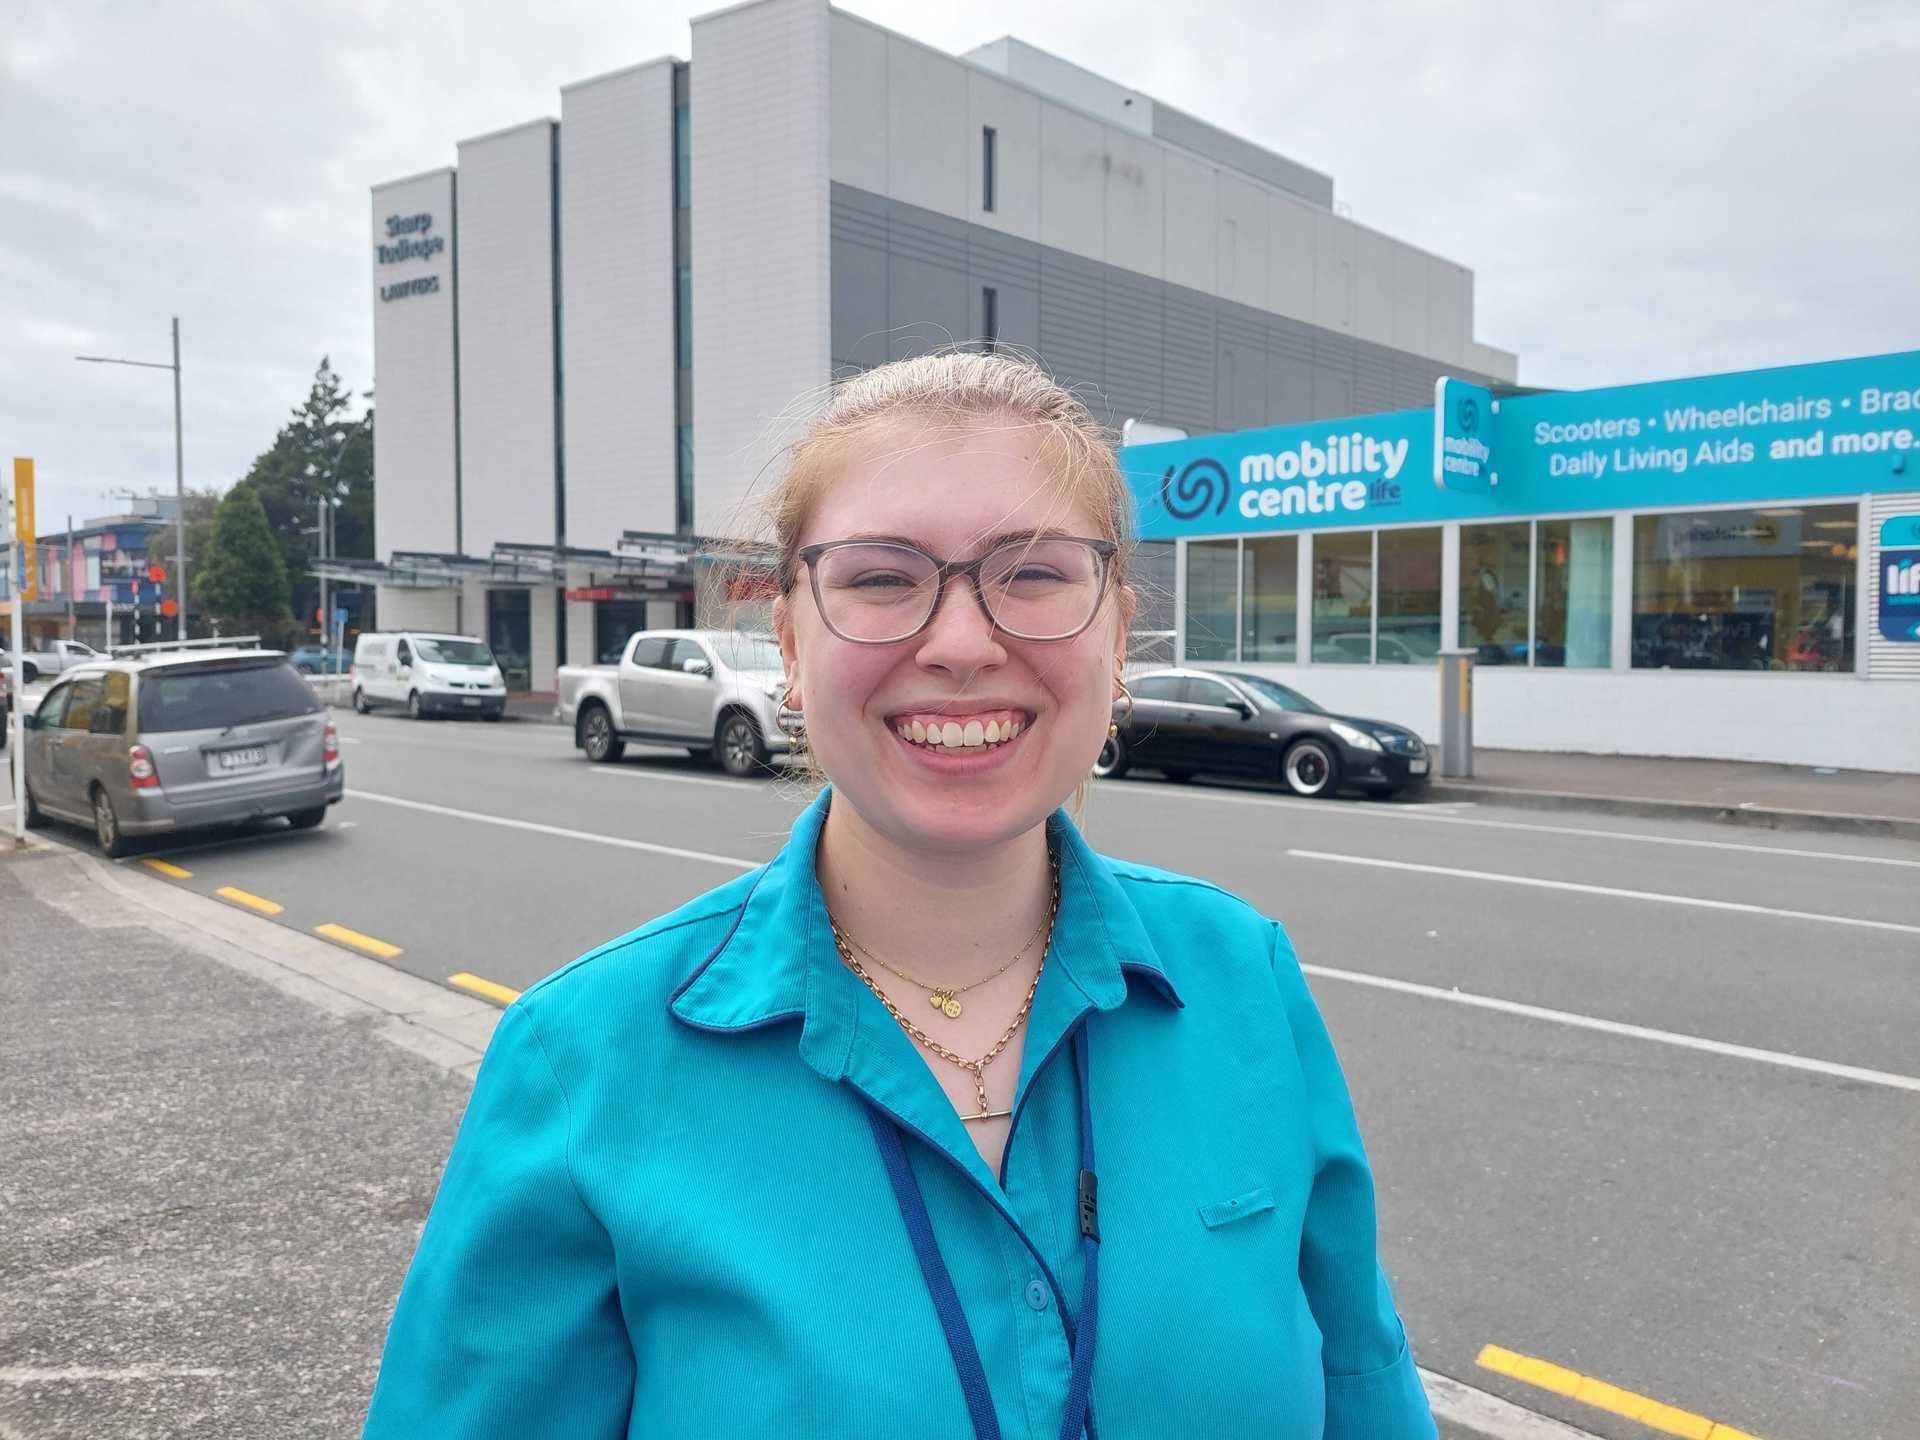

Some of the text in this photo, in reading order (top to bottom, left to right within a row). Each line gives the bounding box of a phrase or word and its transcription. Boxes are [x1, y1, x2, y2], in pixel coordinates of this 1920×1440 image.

[1534, 413, 1641, 446] Scooters
[1663, 396, 1832, 433] Wheelchairs
[1239, 432, 1409, 479] mobility
[1549, 449, 1608, 479] Daily
[1613, 442, 1688, 473] Living
[1694, 438, 1755, 466] Aids
[1769, 431, 1824, 461] and
[1239, 479, 1367, 519] centre
